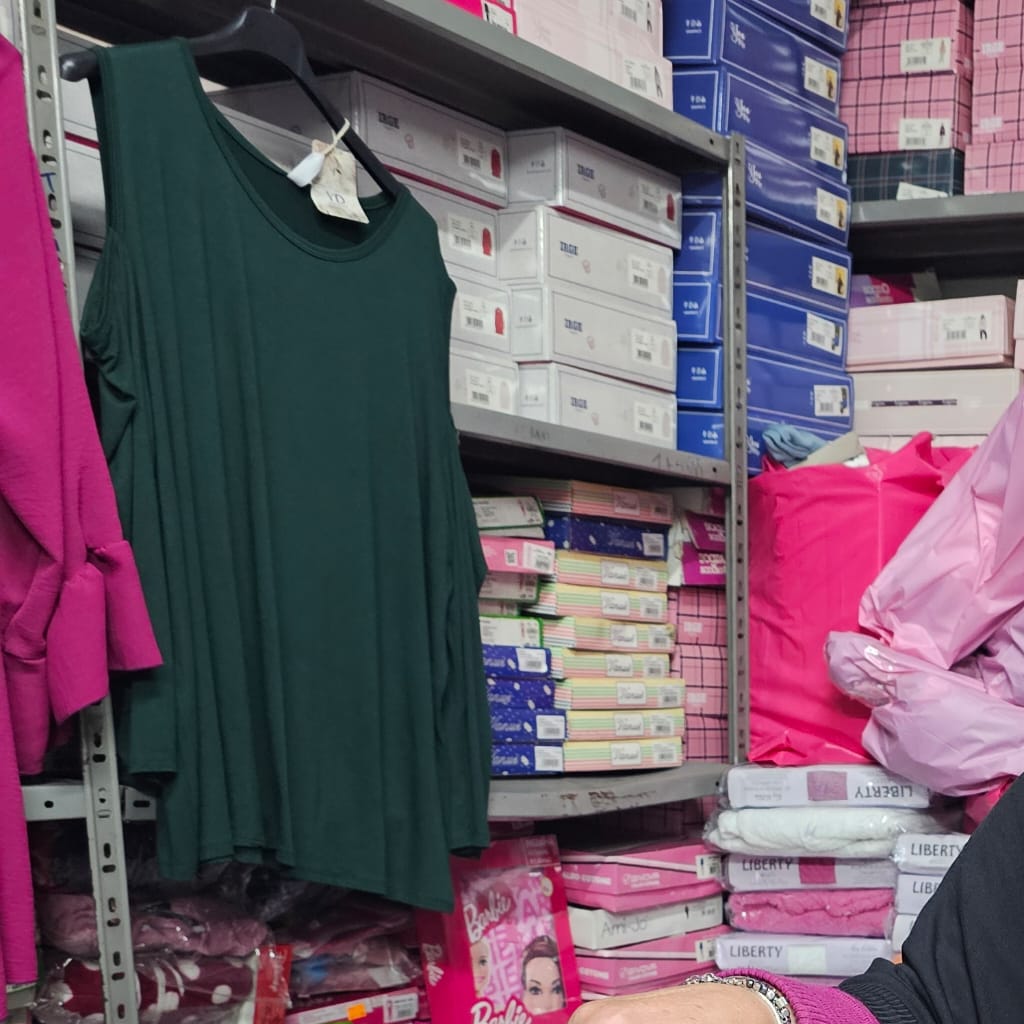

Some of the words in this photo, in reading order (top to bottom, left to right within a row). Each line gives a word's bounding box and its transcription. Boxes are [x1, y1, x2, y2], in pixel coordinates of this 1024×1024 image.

[855, 785, 913, 798] LIBERTY
[742, 858, 793, 871] LIBERTY
[463, 887, 511, 943] Barbie
[729, 945, 783, 958] LIBERTY
